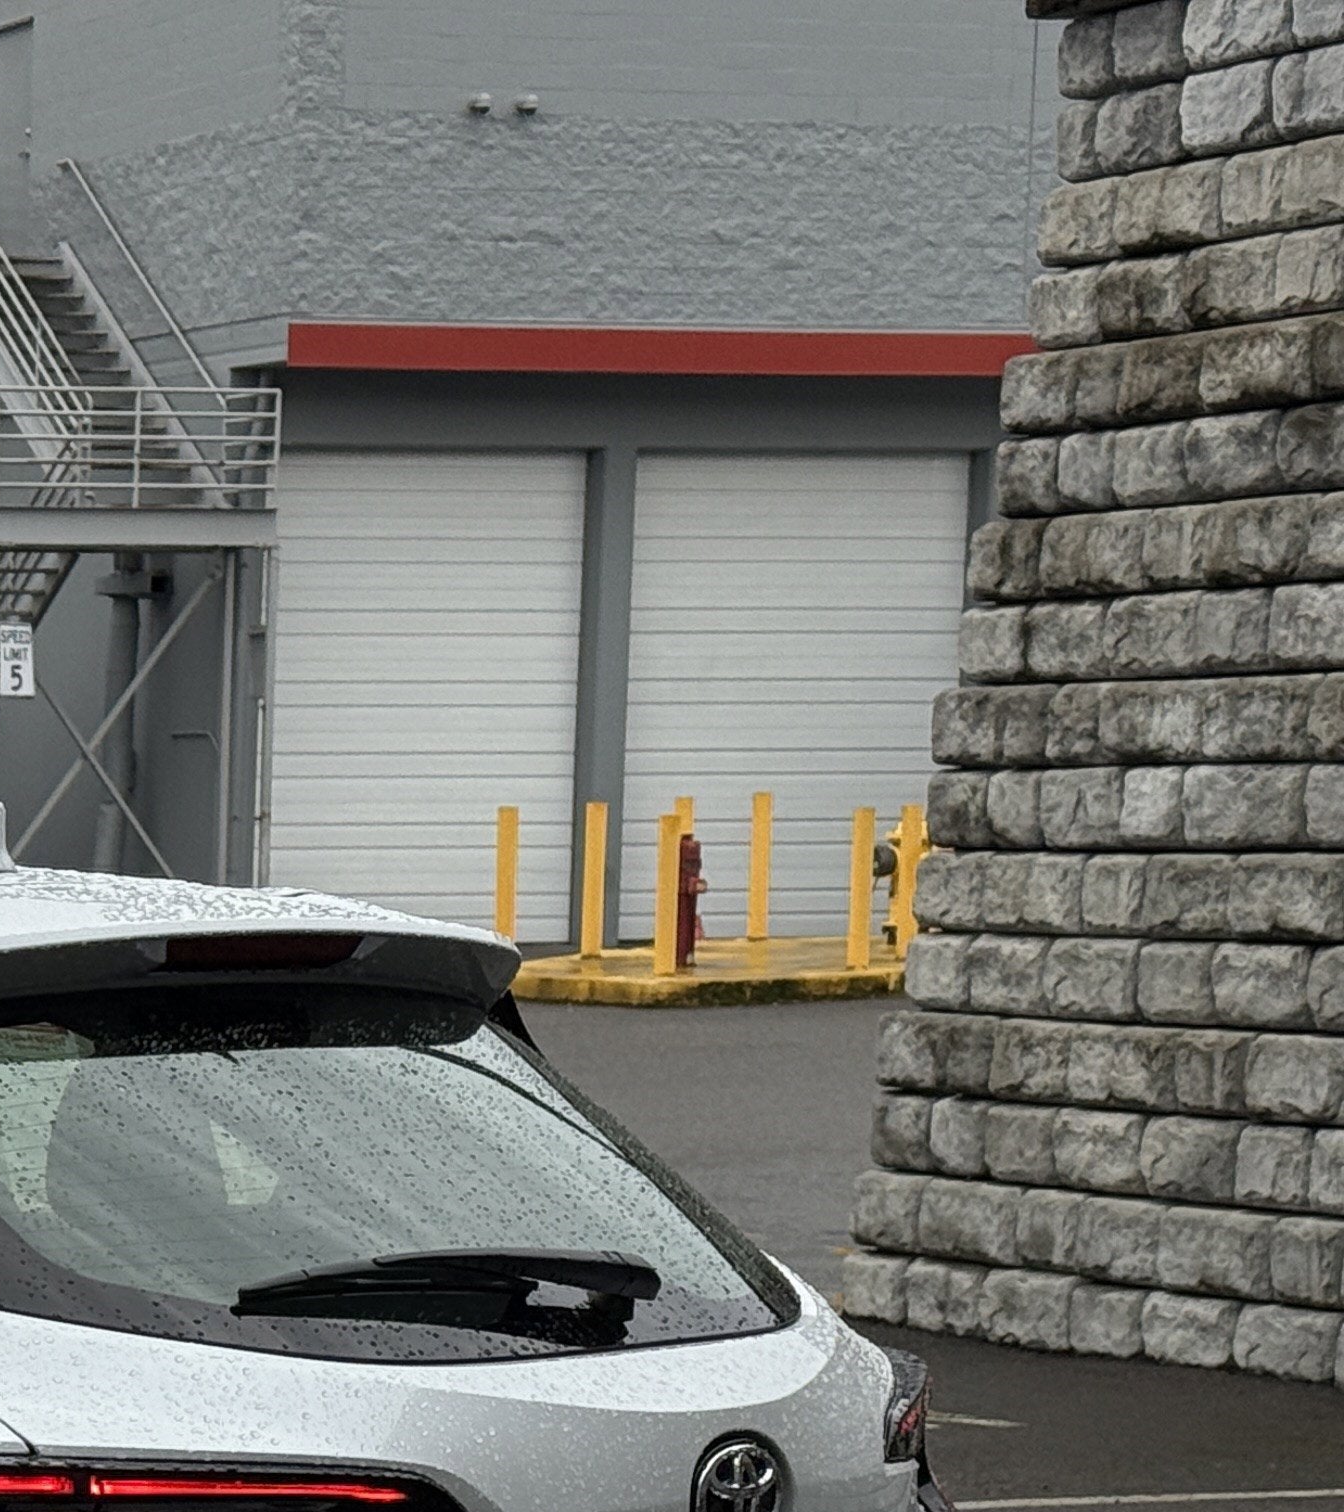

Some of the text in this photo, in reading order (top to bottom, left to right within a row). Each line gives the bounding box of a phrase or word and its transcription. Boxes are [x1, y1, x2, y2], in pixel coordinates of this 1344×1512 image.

[0, 629, 32, 644] SPEED
[3, 646, 29, 661] LIMIT
[10, 664, 23, 691] 5
